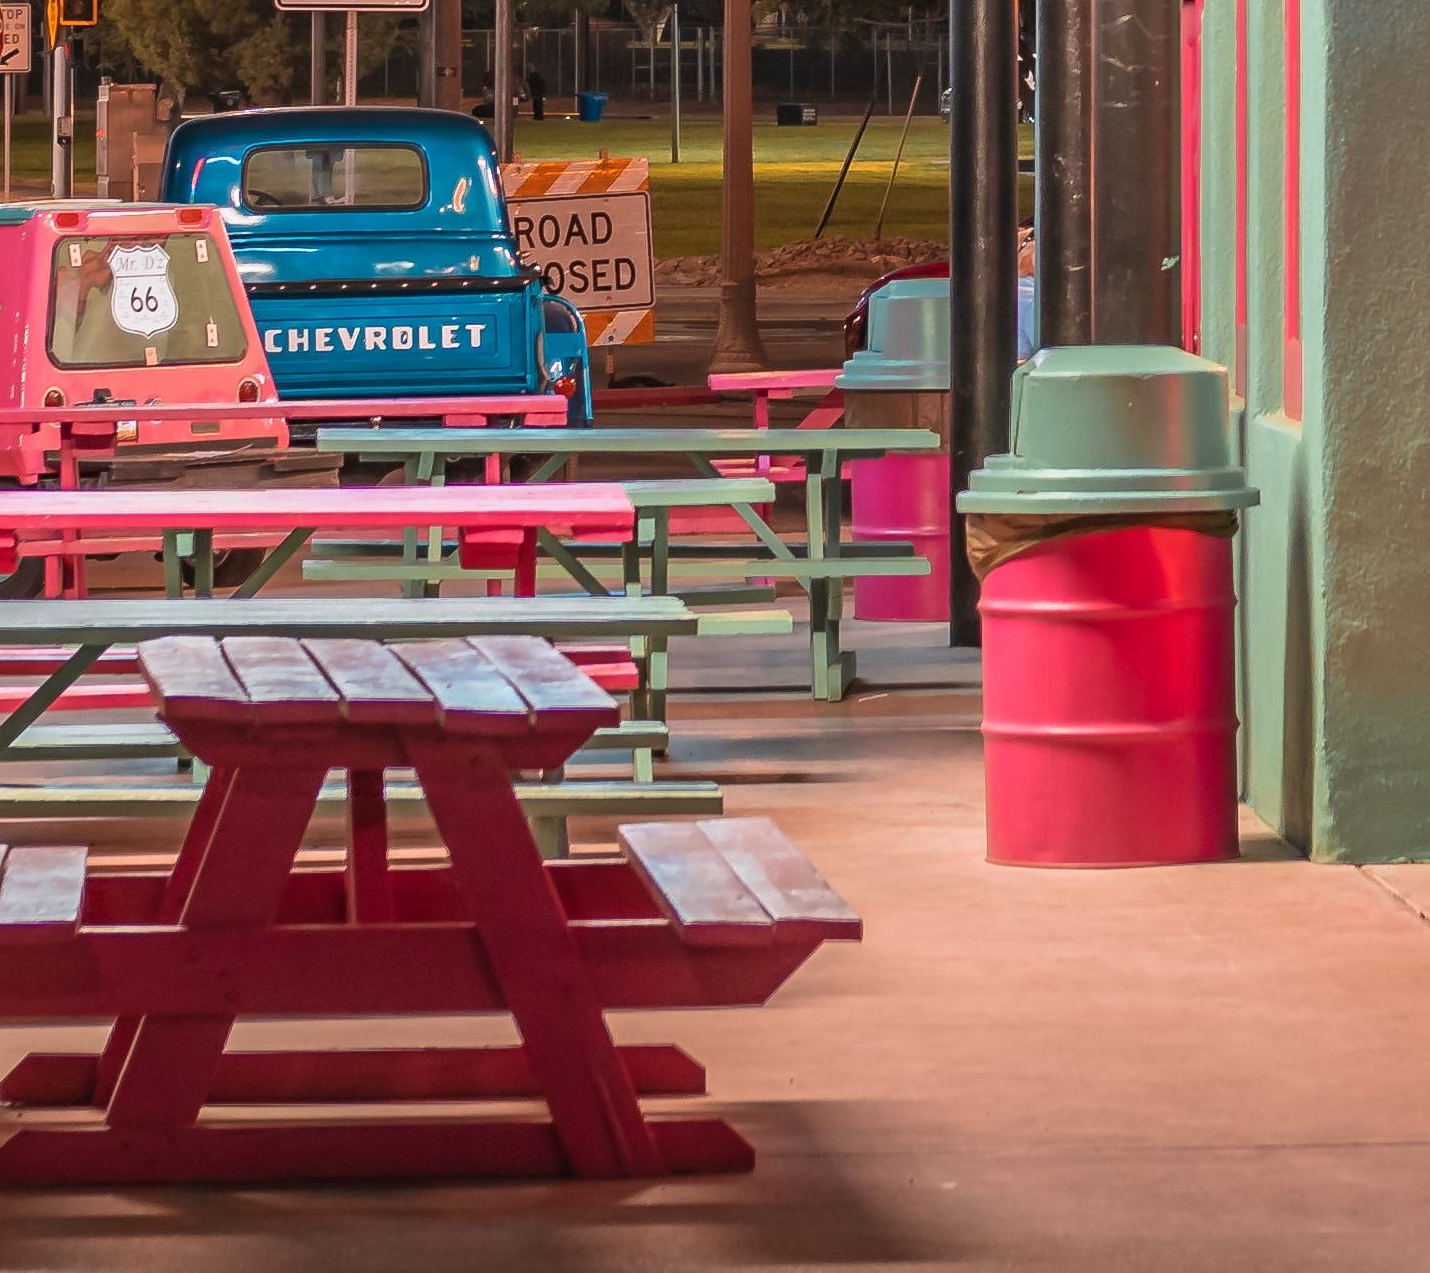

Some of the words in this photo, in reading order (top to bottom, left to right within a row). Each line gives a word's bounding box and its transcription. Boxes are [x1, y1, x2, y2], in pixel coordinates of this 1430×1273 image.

[4, 34, 20, 44] ED
[513, 211, 614, 251] ROAD
[544, 256, 637, 296] OSED
[131, 286, 158, 312] 66
[264, 324, 486, 354] CHEVROLET
